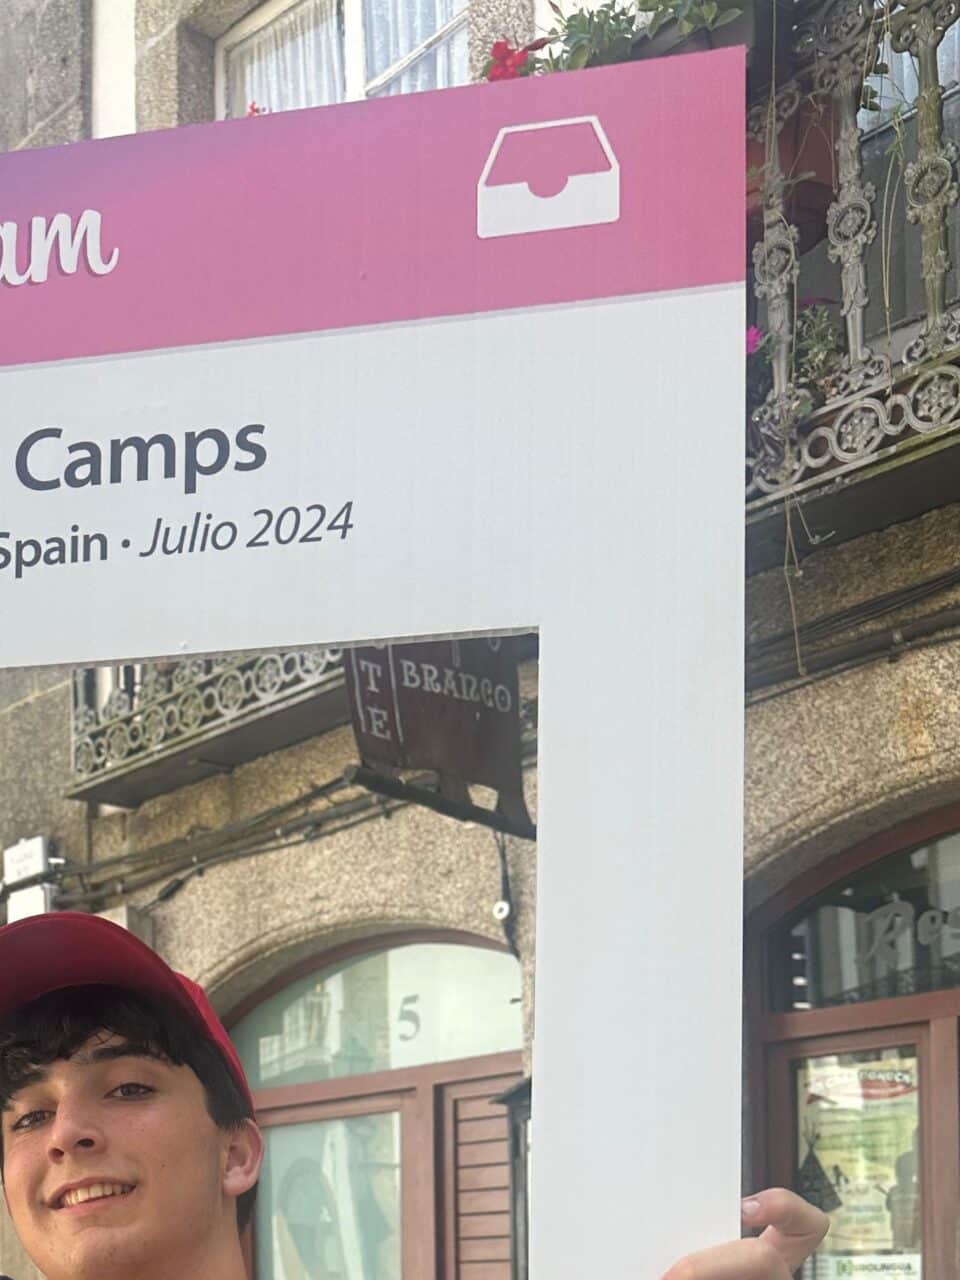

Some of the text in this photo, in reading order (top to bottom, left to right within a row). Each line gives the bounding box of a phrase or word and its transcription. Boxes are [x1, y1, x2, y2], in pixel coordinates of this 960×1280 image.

[14, 423, 268, 495] Camps
[139, 511, 238, 558] Julio
[245, 500, 355, 548] 2024
[397, 993, 421, 1042] 5
